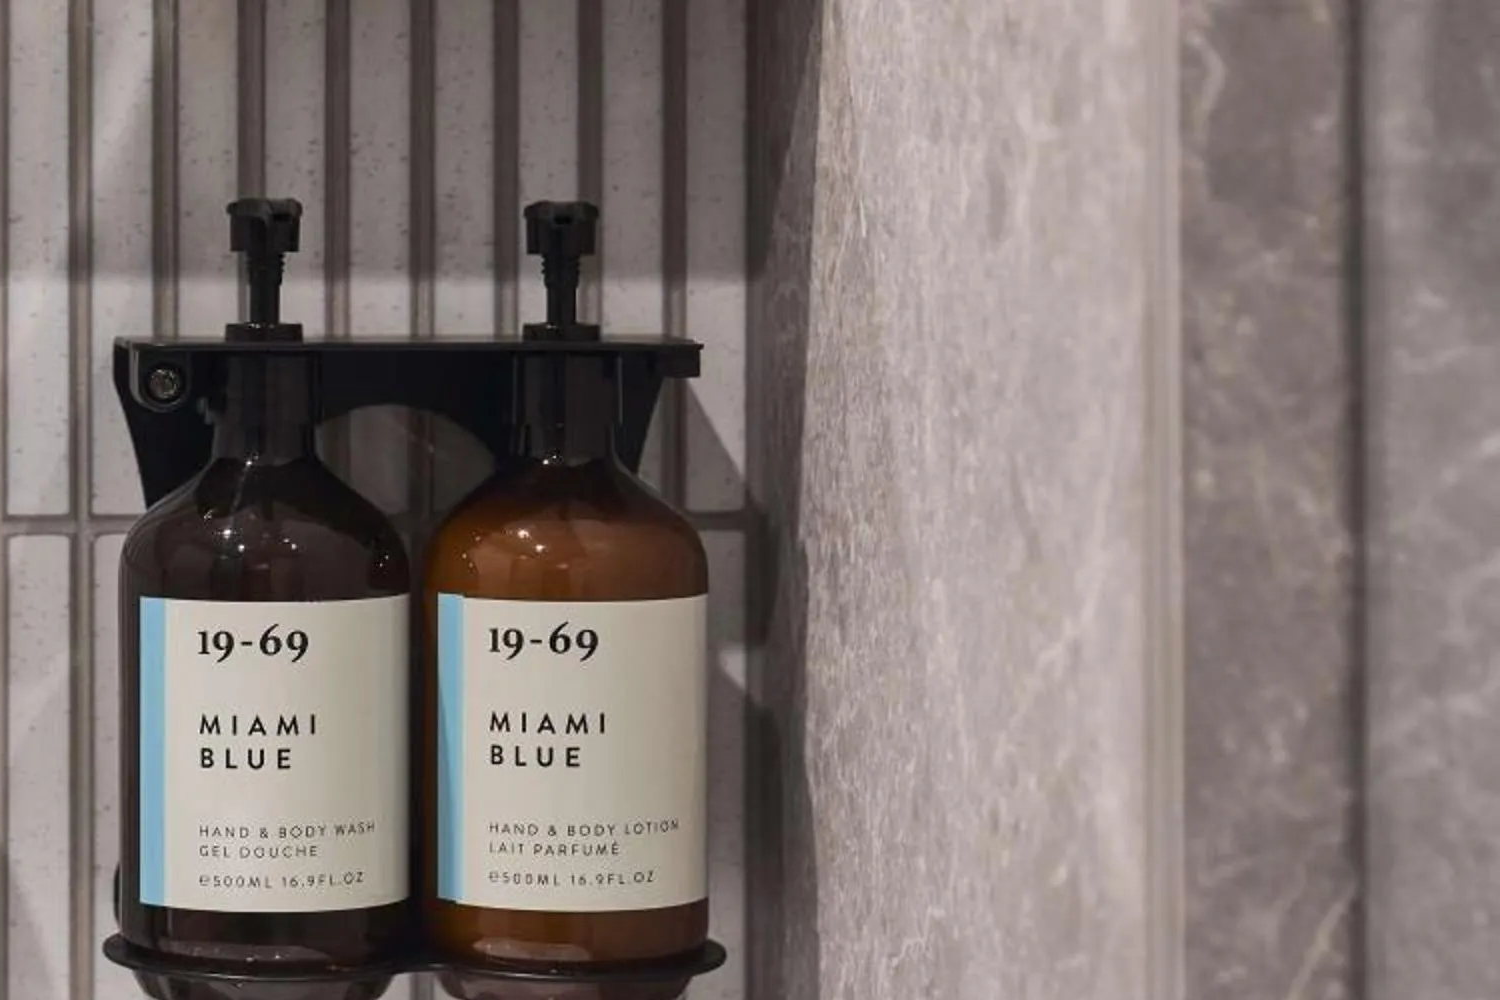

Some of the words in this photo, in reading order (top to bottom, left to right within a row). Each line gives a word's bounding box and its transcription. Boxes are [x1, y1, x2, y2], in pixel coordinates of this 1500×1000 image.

[197, 624, 309, 663] 19-69
[489, 621, 599, 662] 19-69
[199, 714, 317, 737] MIAMI
[489, 711, 606, 735] MIAMI
[200, 747, 292, 771] BLUE
[490, 743, 581, 768] BLUE
[199, 825, 250, 839] HAND
[259, 826, 269, 839] &
[278, 824, 327, 839] BODY
[334, 821, 376, 837] WASH
[489, 822, 539, 837] HAND
[547, 824, 558, 837] &
[567, 823, 616, 837] BODY
[624, 819, 680, 836] LOTION
[199, 845, 231, 858] GEL
[239, 845, 318, 859] DOUCHE
[489, 841, 525, 855] LAIT
[533, 840, 620, 857] PARFUMÉ
